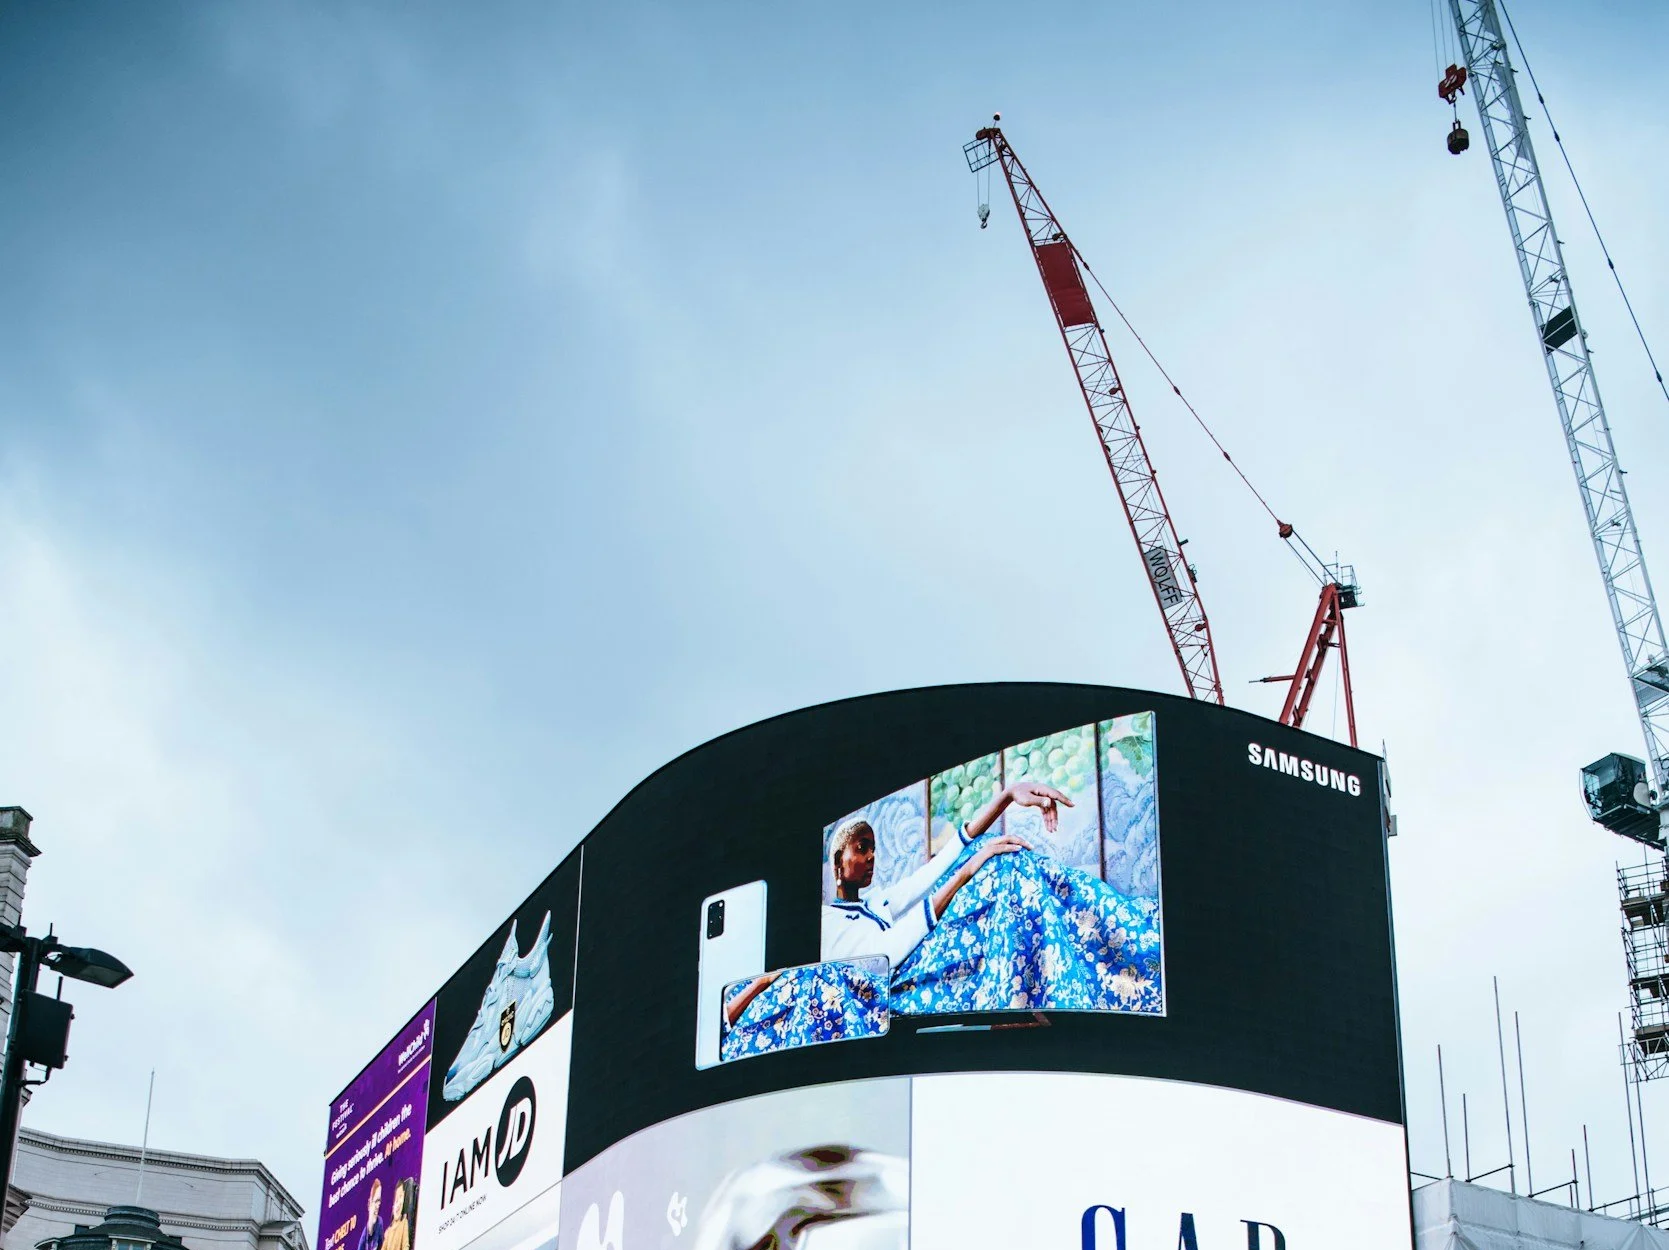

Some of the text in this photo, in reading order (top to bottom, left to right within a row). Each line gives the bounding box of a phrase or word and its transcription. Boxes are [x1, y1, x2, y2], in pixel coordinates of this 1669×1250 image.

[1150, 552, 1178, 604] WOLFF
[1248, 742, 1361, 796] SAMSUNG
[339, 1099, 349, 1113] THE
[328, 1187, 341, 1209] best
[340, 1173, 360, 1197] chance
[392, 1128, 412, 1152] home.
[331, 1163, 348, 1186] Giving
[347, 1140, 371, 1171] seriously
[377, 1114, 400, 1144] children
[400, 1104, 412, 1123] the
[440, 1096, 532, 1211] I AM JD
